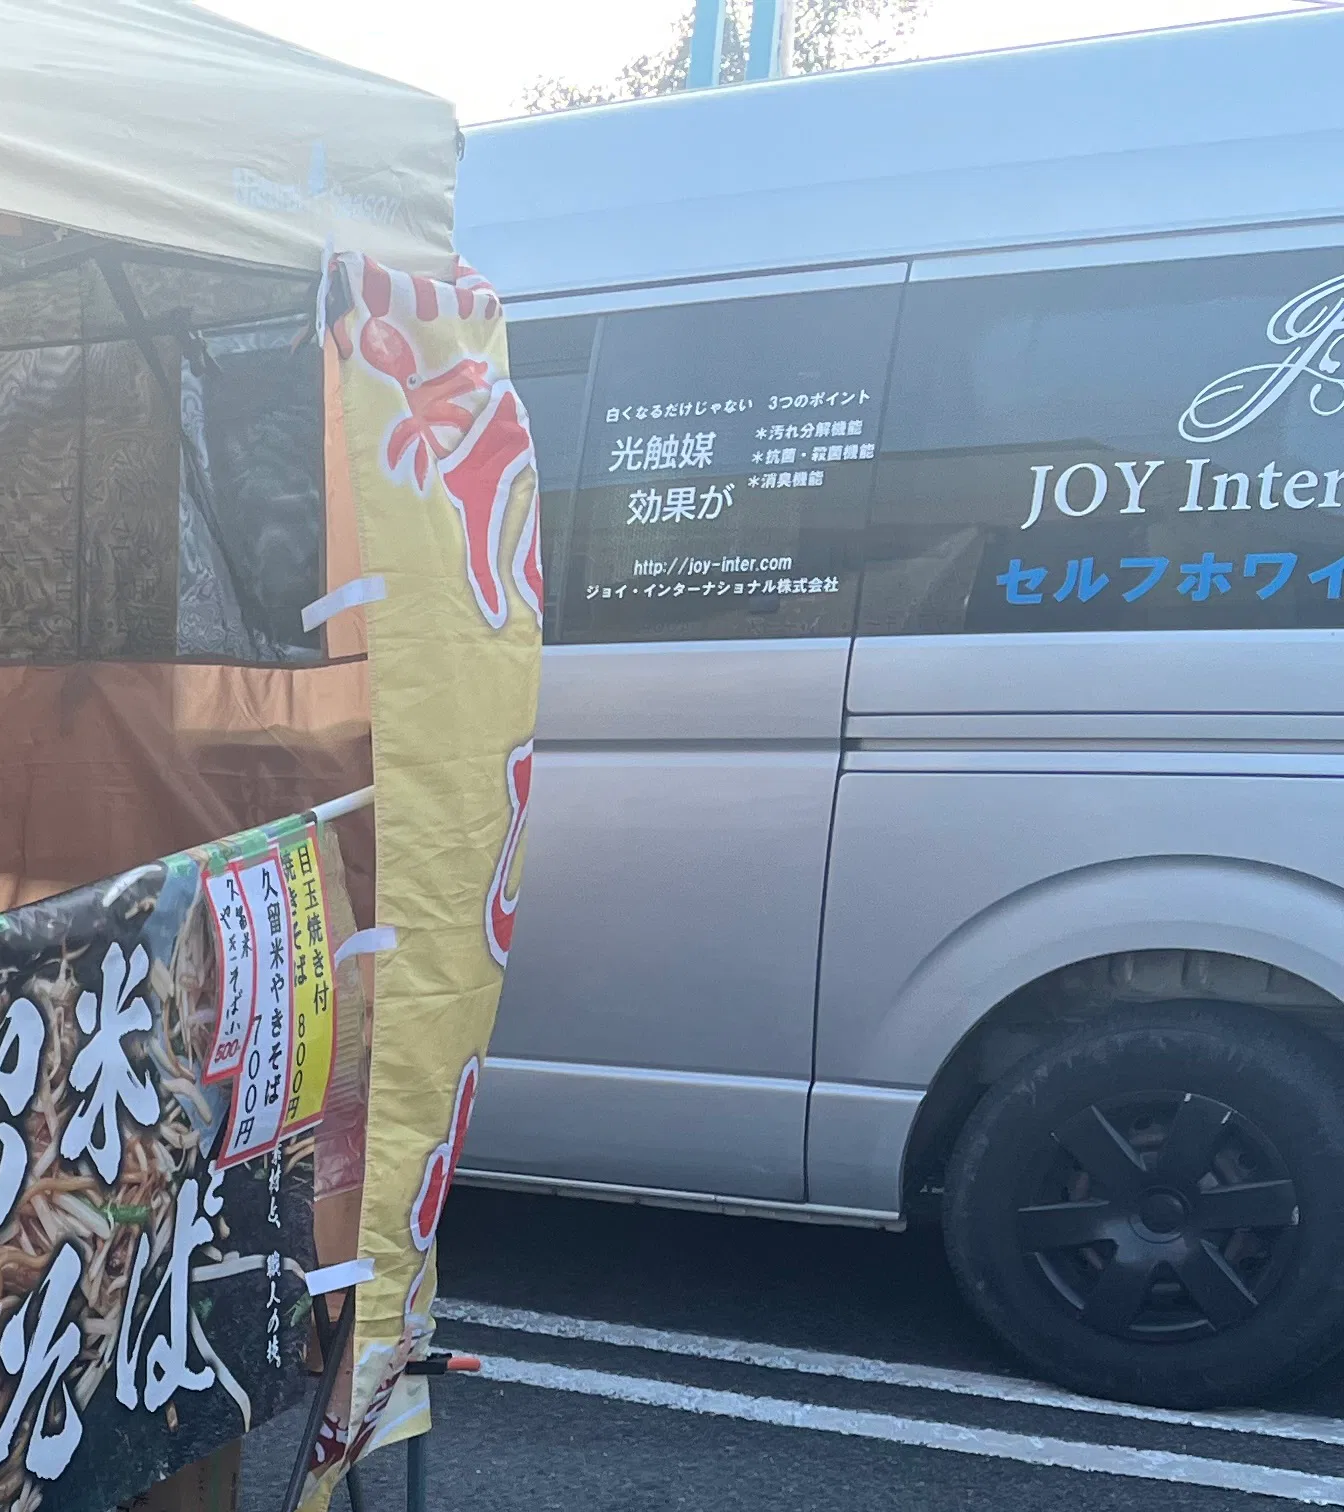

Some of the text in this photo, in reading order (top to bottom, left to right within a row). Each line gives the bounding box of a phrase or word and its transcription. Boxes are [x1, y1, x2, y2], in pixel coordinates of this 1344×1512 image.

[606, 389, 871, 423] 白くなるだけじゃない 3つのポイント
[608, 431, 717, 473] 光触媒
[626, 483, 735, 526] 効果が
[1020, 459, 1165, 531] JOY
[633, 555, 793, 577] http://joy-inter.com
[585, 576, 840, 601] ジョイ・インターナショナル株式会社
[297, 843, 329, 1016] 目玉焼き付
[262, 867, 286, 1107] 久留米やきそば
